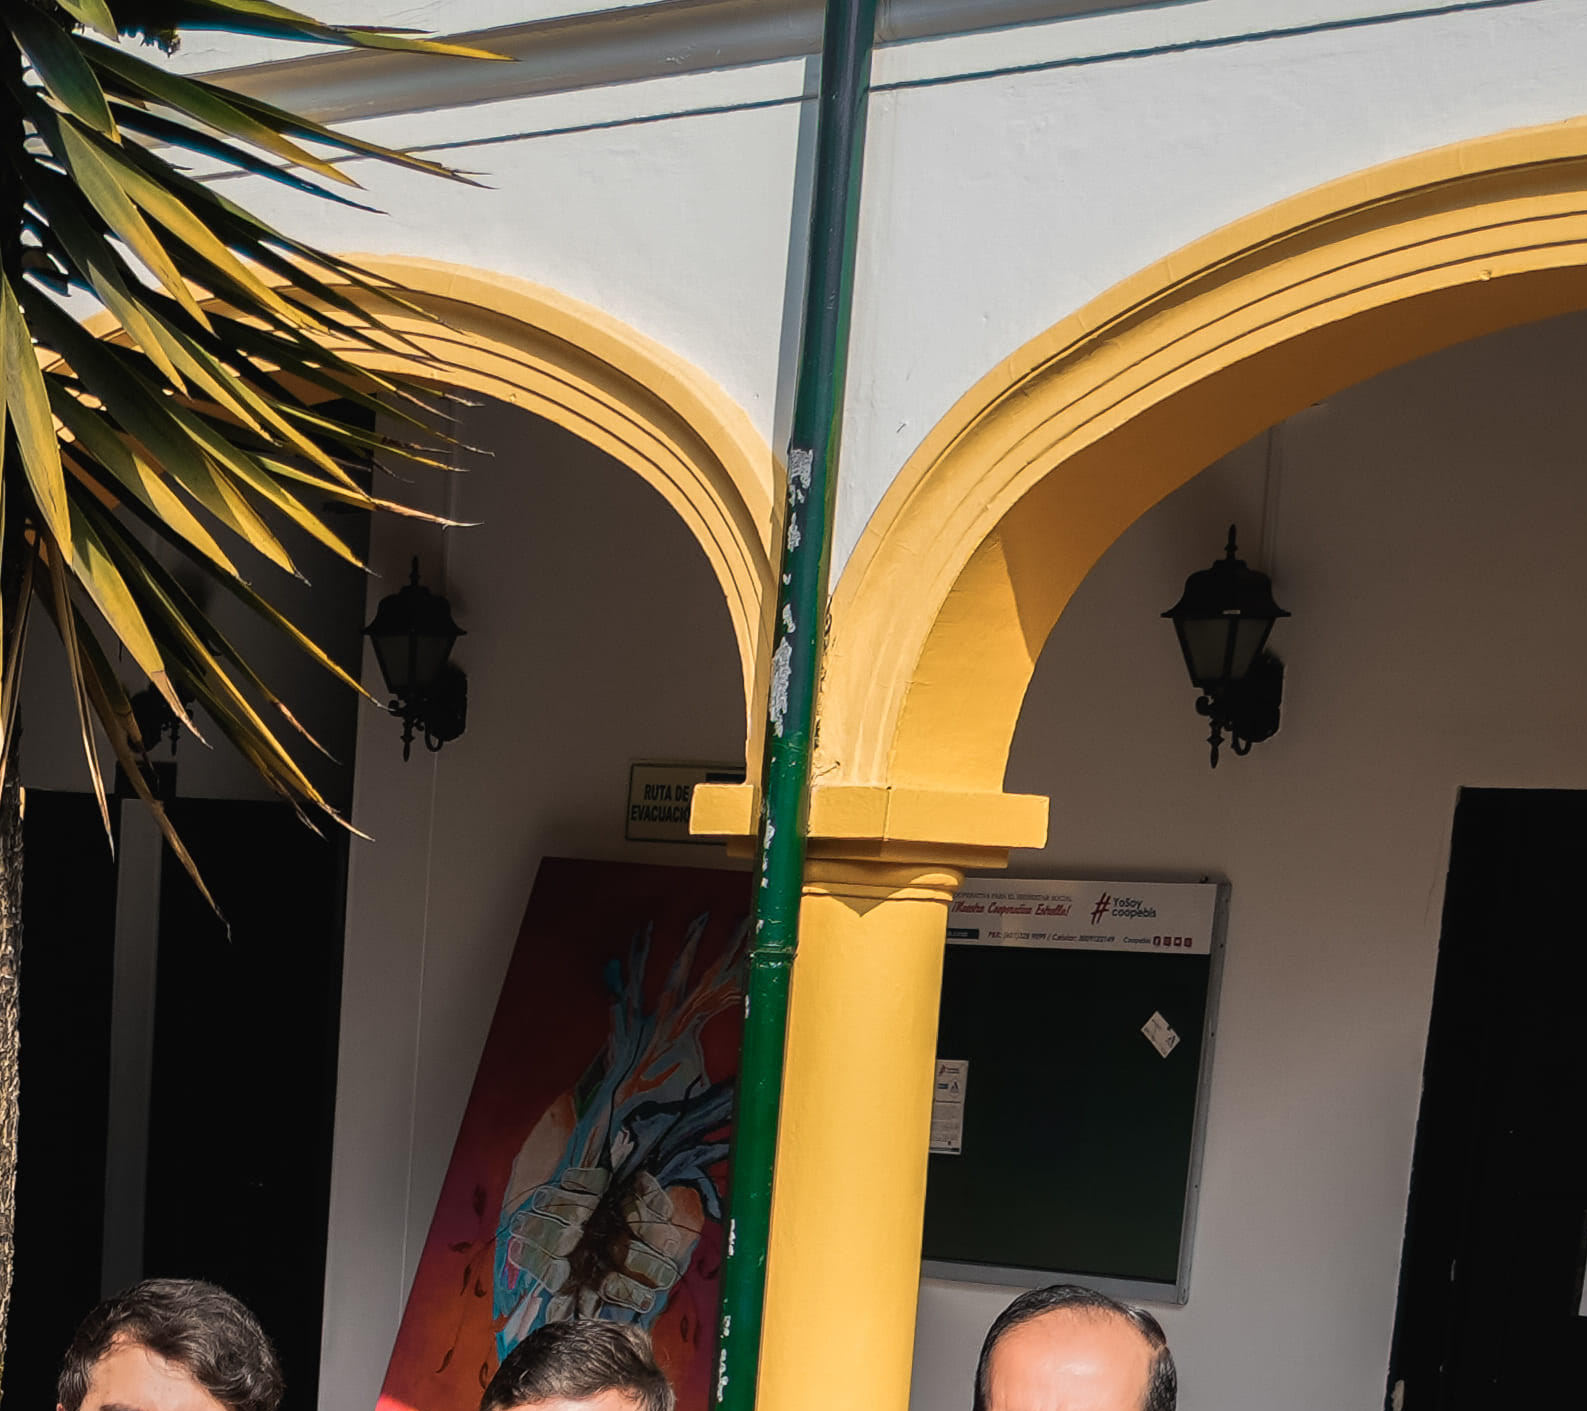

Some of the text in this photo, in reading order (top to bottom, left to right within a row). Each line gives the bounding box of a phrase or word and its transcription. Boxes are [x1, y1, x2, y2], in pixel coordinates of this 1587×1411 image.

[644, 784, 689, 802] RUTA DE
[630, 805, 690, 823] EVACUACI
